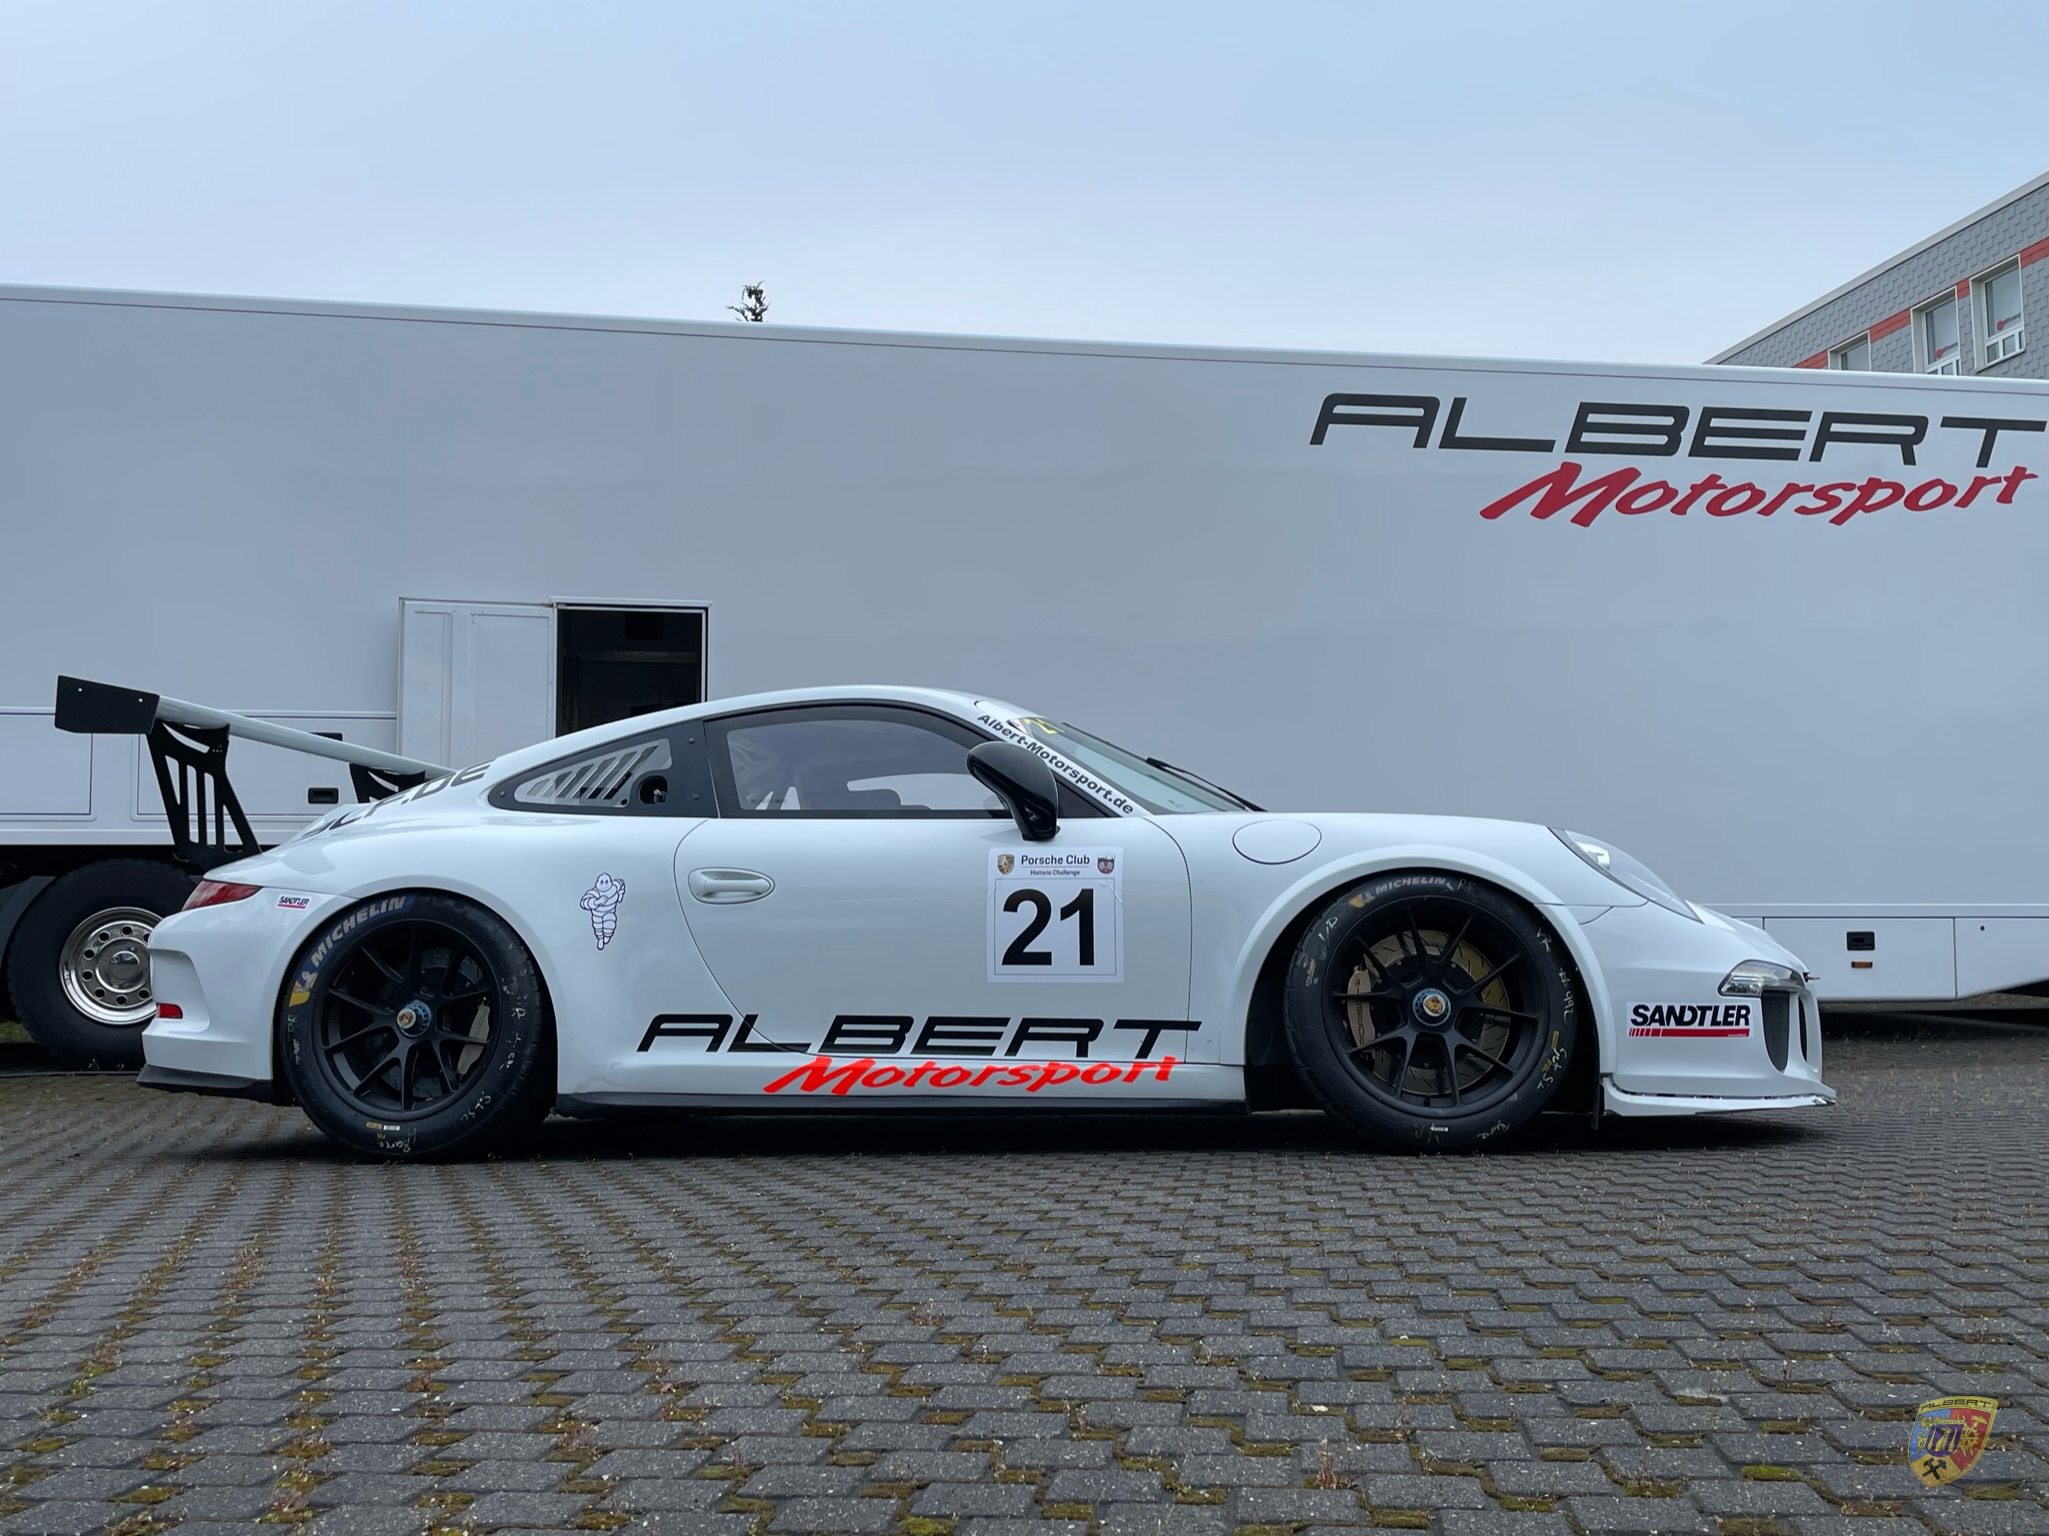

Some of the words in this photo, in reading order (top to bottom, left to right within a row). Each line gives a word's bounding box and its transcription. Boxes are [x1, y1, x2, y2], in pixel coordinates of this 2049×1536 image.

[1309, 392, 2048, 468] ALBERT
[1478, 461, 2039, 528] Motorsport
[977, 714, 1134, 814] Albert-Motorsport.de
[1021, 854, 1064, 865] Porsche
[1066, 854, 1090, 865] Club
[1053, 869, 1080, 877] Challenge
[1375, 876, 1447, 895] MICHELIN
[310, 896, 407, 967] MICHELIN
[1001, 888, 1095, 966] 21
[636, 1013, 1203, 1060] ALBERT
[1630, 1003, 1751, 1027] SANDTLER
[762, 1055, 1185, 1097] Motorsport
